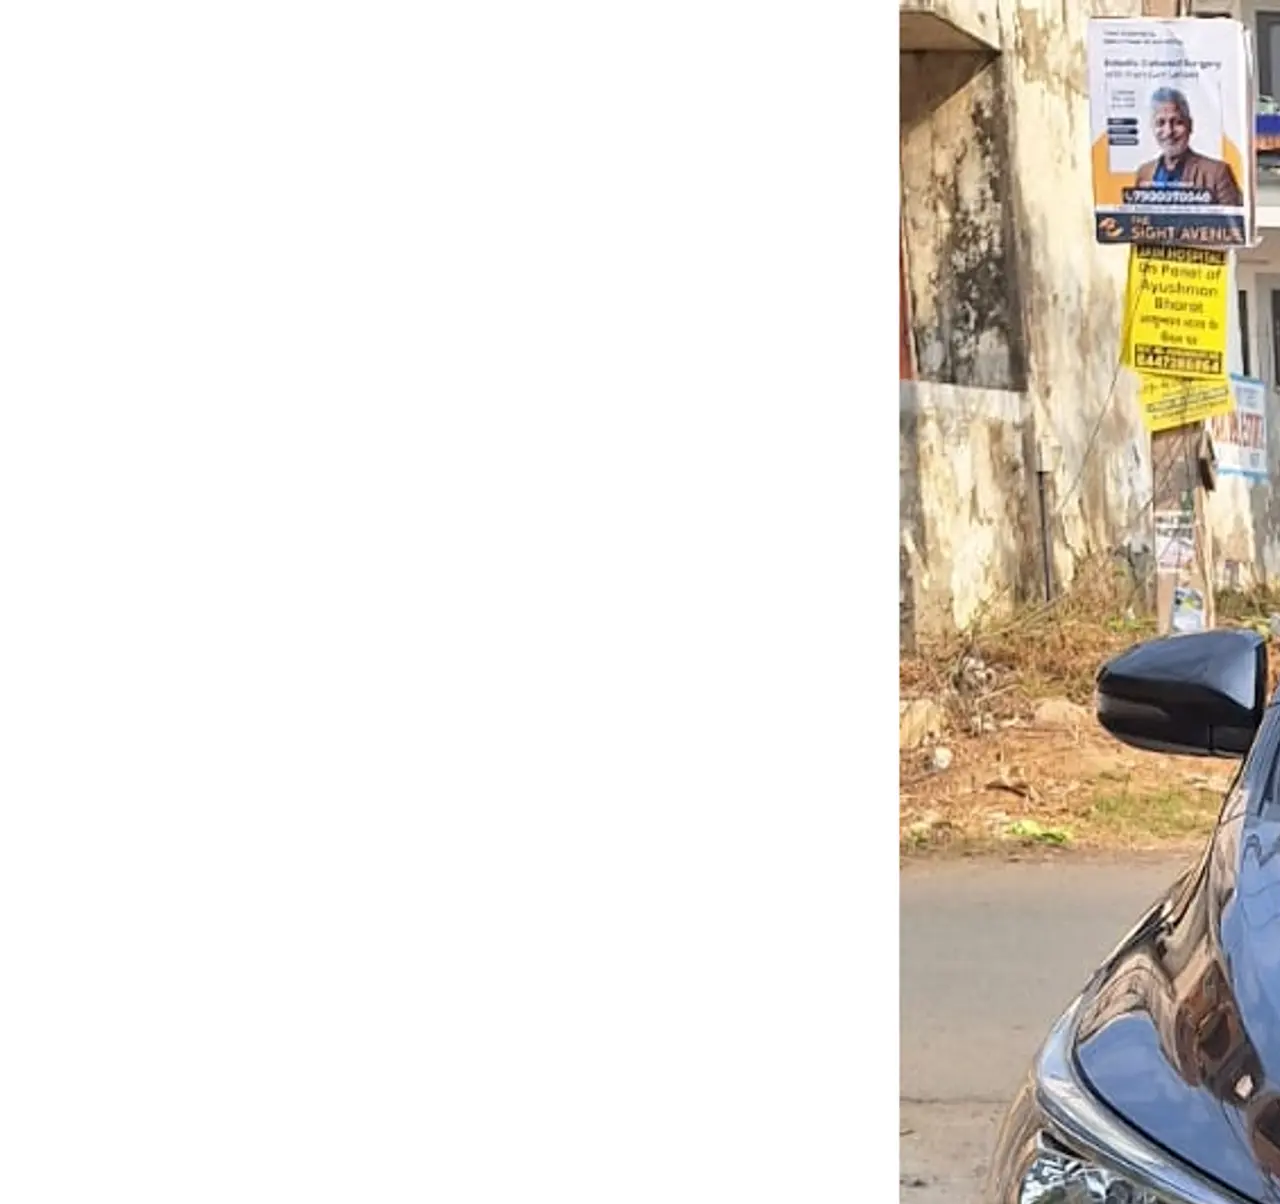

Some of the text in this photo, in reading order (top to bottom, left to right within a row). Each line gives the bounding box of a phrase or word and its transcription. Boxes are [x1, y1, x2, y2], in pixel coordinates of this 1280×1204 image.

[1131, 226, 1174, 240] SIGHT
[1162, 264, 1201, 279] Panel
[1205, 267, 1222, 281] of
[1140, 278, 1218, 296] Ayushman
[1154, 296, 1204, 313] Bharat
